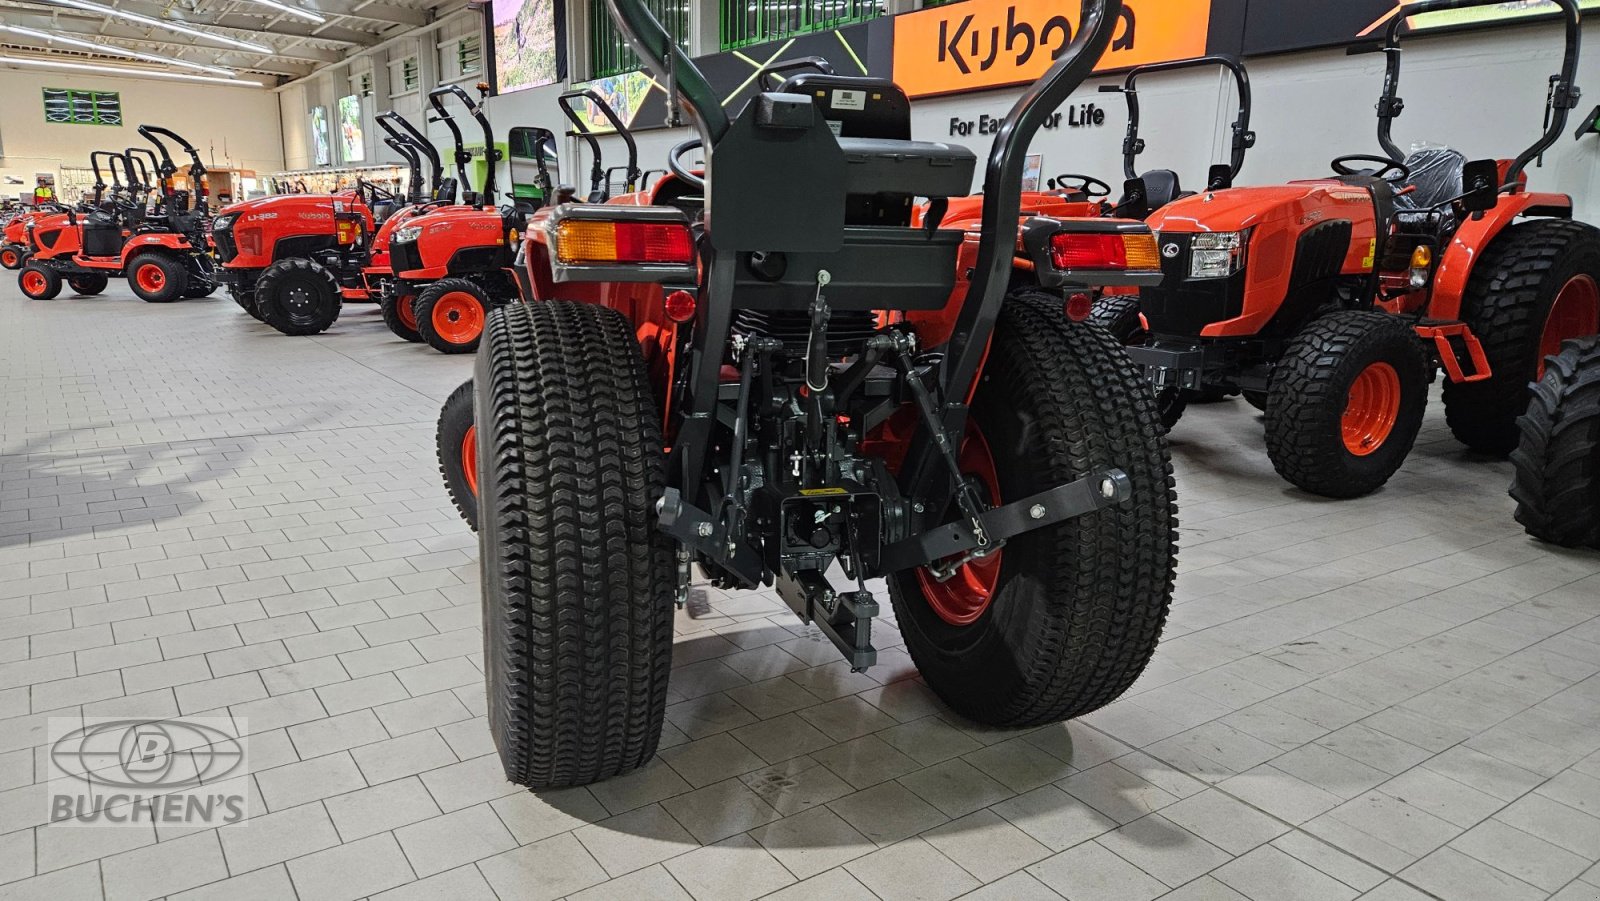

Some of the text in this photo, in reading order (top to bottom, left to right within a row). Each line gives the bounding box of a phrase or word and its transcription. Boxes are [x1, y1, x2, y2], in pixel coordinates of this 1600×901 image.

[938, 4, 1136, 75] Kuboa
[949, 117, 974, 137] For
[1042, 112, 1062, 129] or
[1068, 103, 1105, 127] Life
